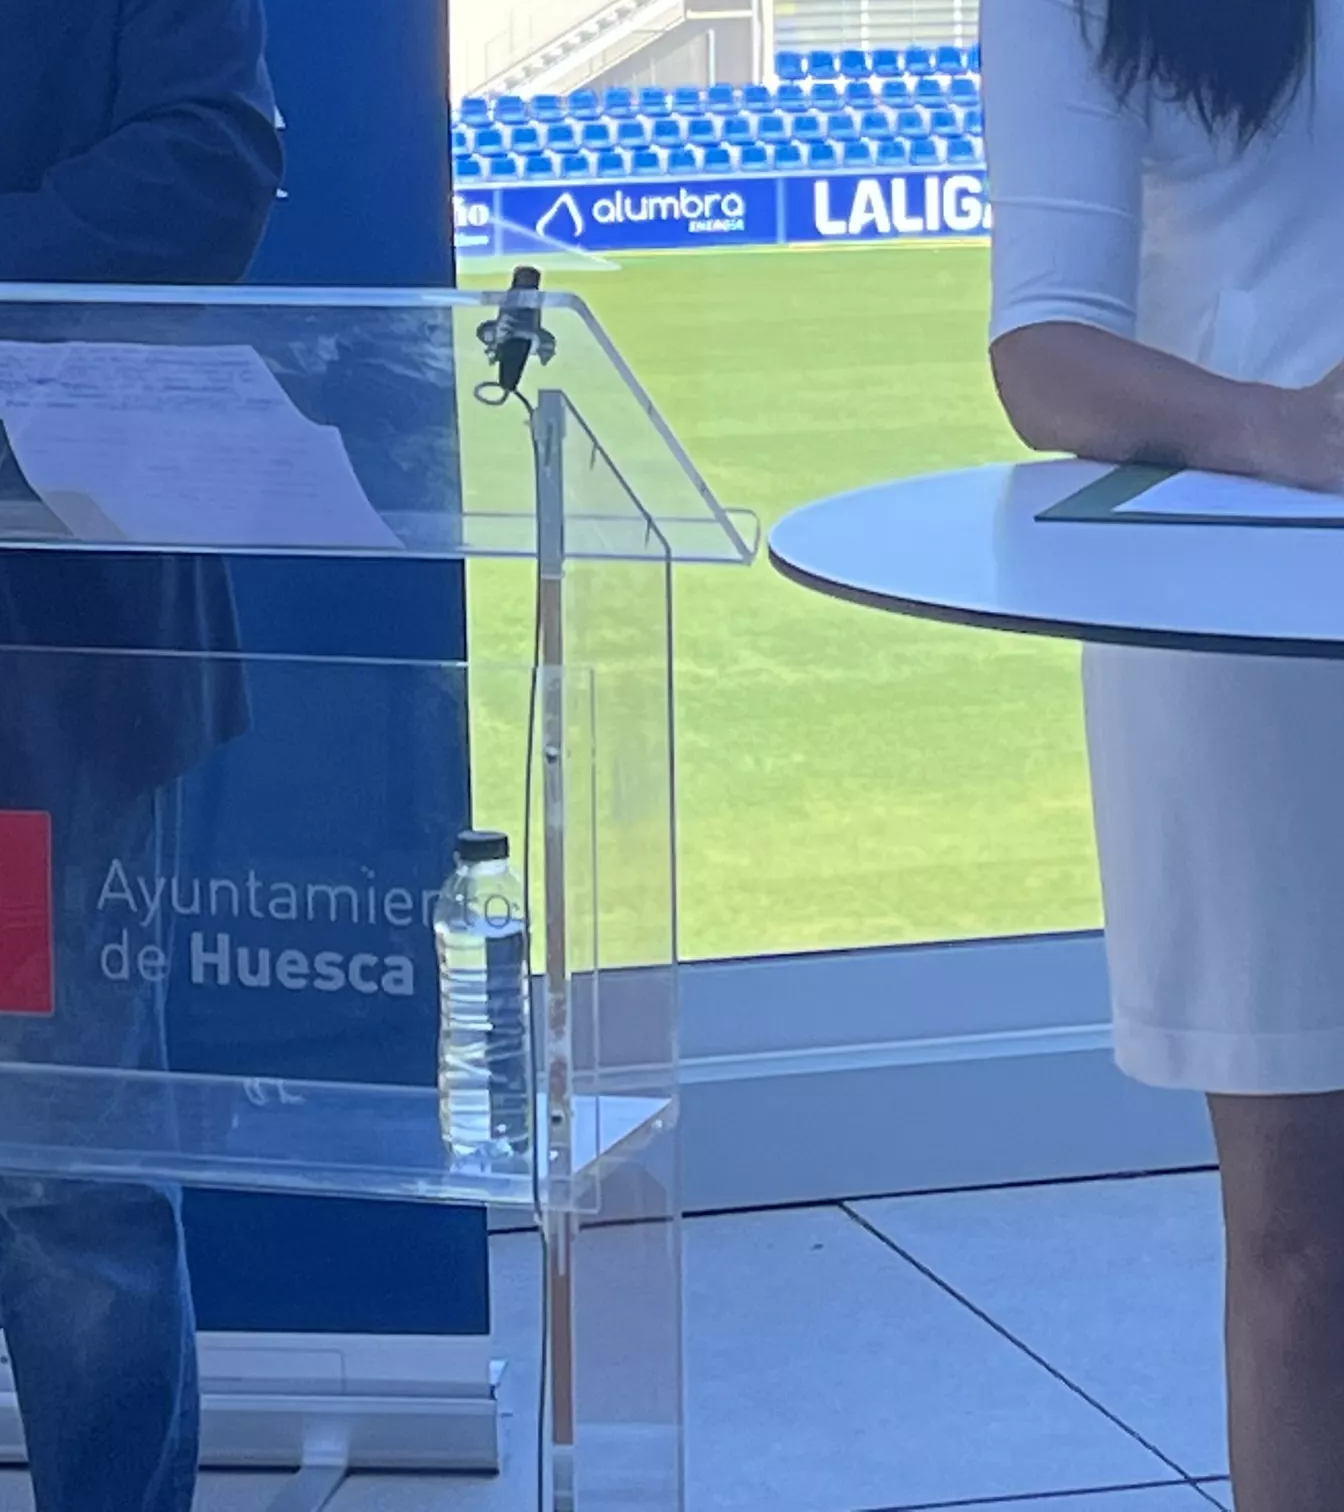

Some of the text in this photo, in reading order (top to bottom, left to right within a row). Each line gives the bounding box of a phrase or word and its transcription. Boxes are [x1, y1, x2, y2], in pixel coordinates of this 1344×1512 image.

[592, 187, 745, 223] alumbra
[814, 175, 992, 234] LALIG
[100, 929, 416, 996] de Huesca
